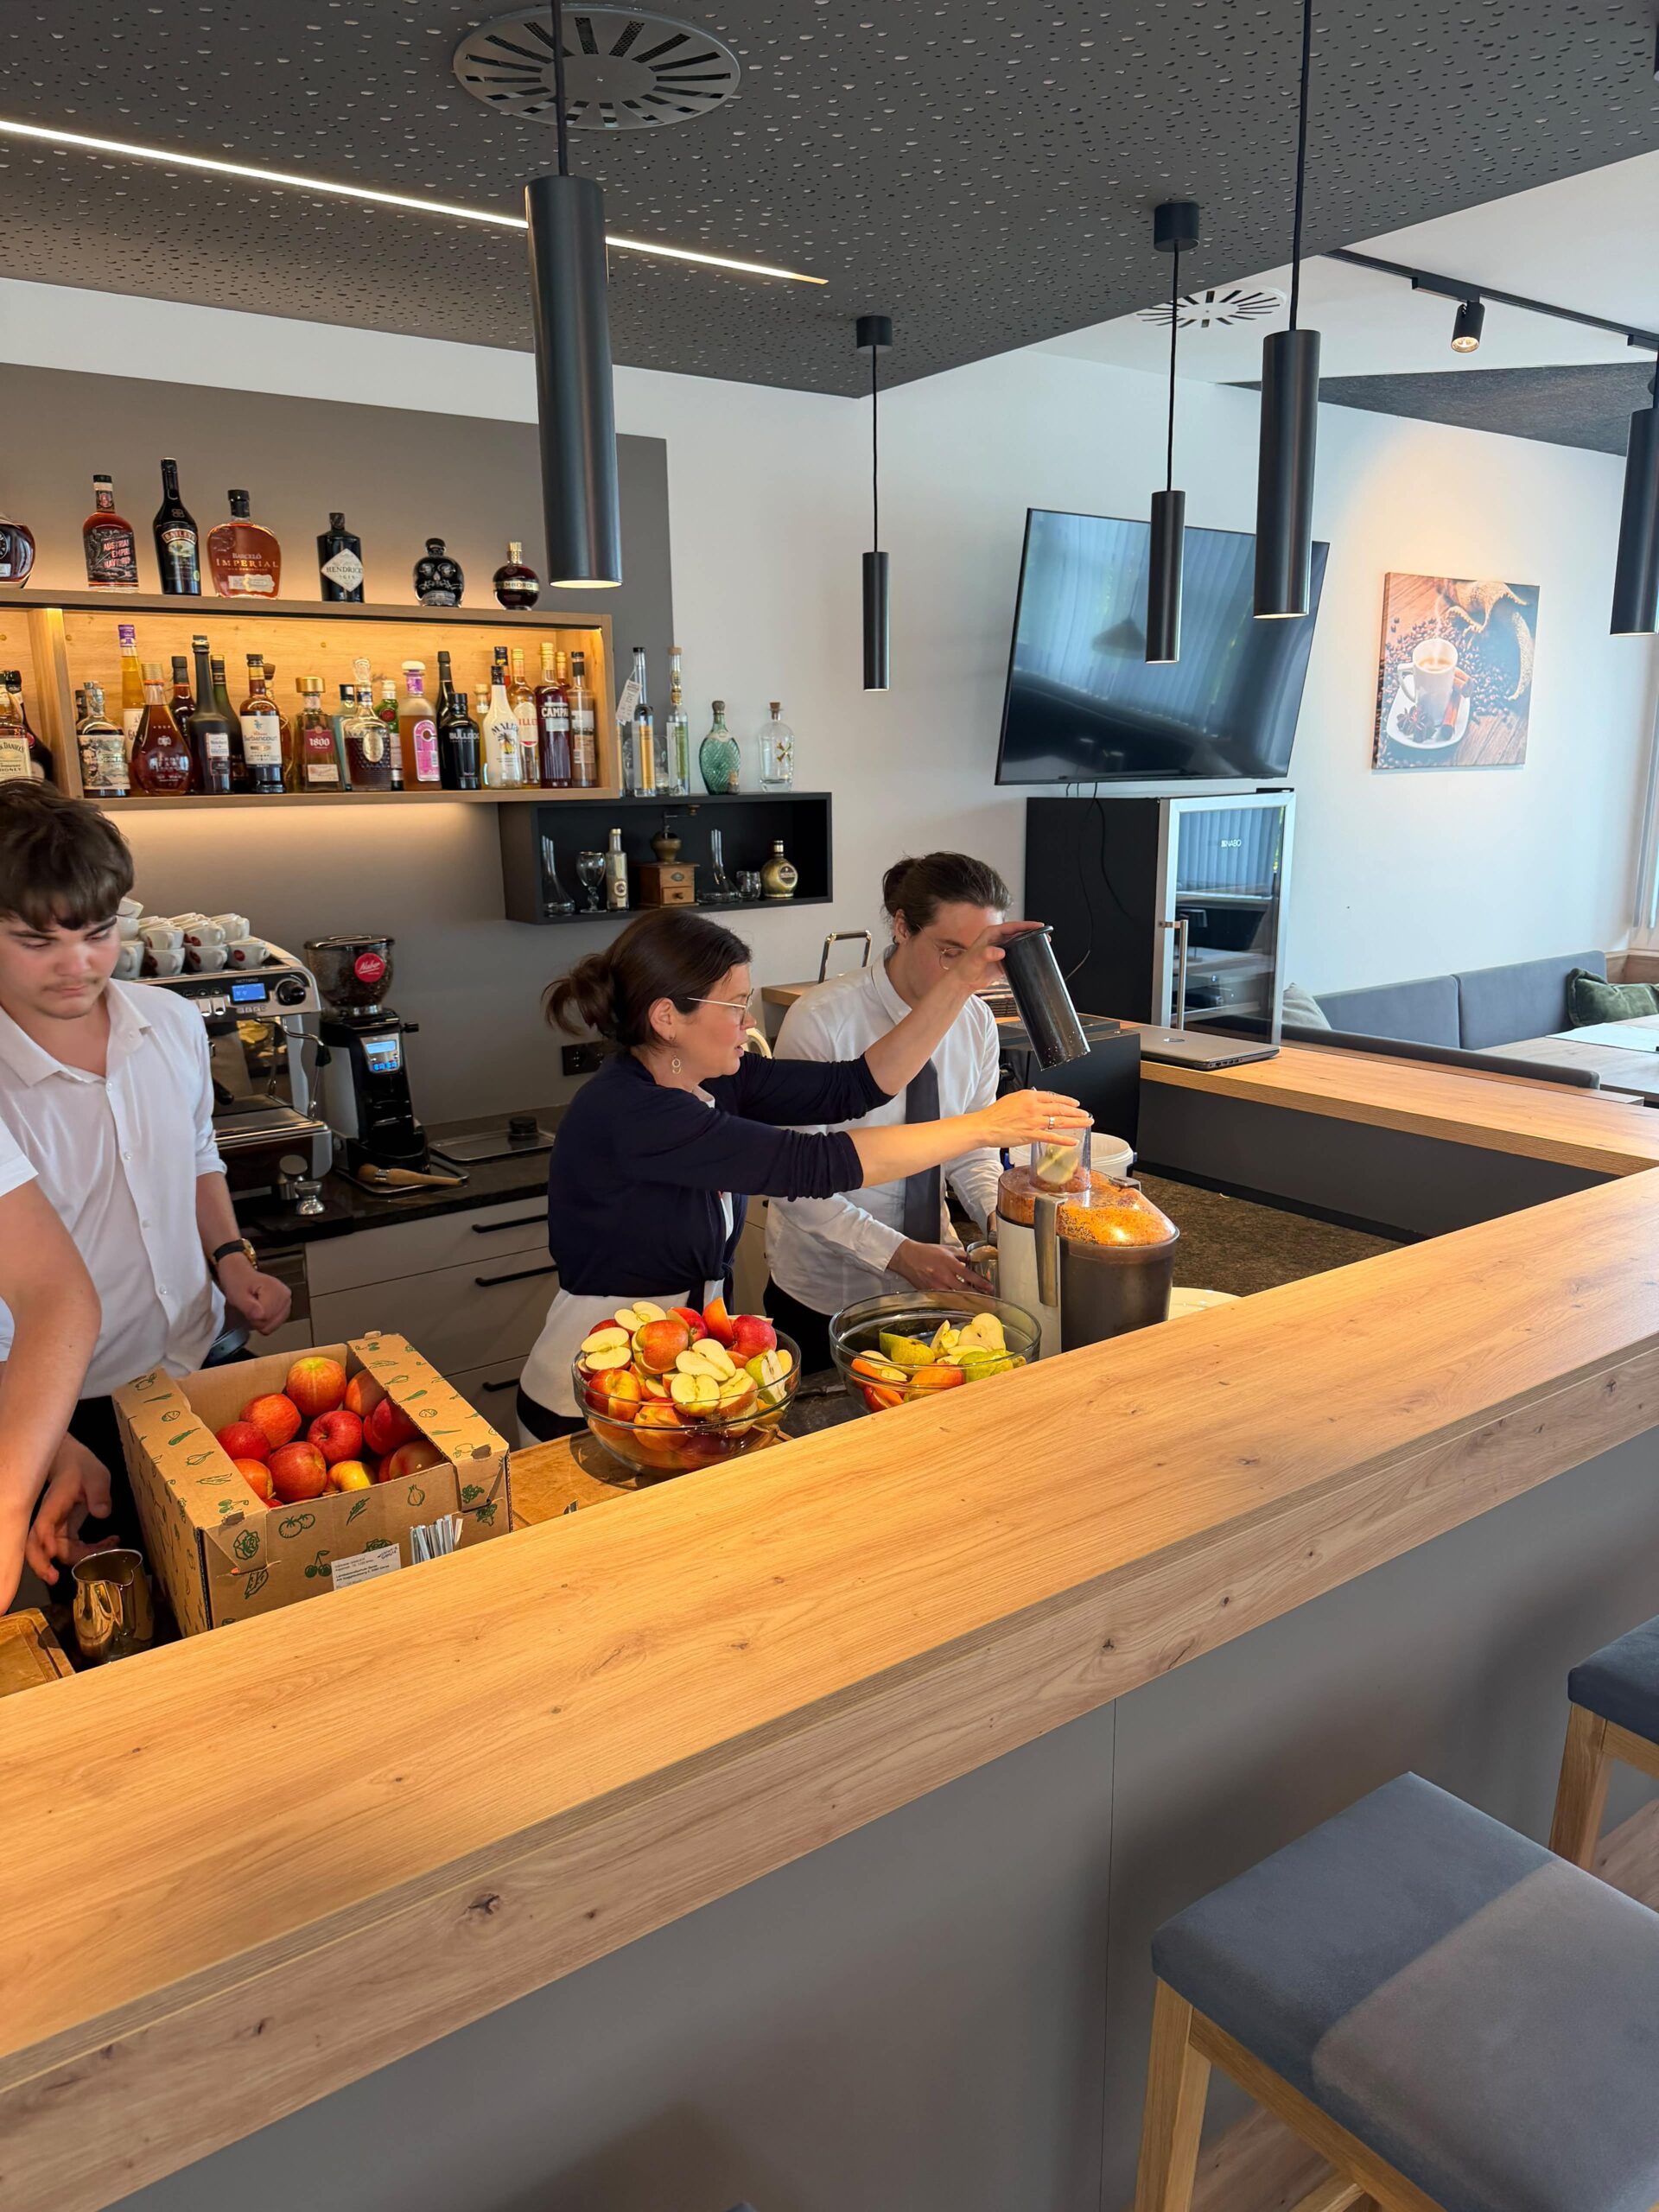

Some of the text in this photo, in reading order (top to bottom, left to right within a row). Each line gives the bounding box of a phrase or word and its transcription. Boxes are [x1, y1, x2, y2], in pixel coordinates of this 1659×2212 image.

[216, 558, 278, 568] IMPERIAL
[541, 707, 569, 717] CAMPA
[308, 737, 331, 747] 1800
